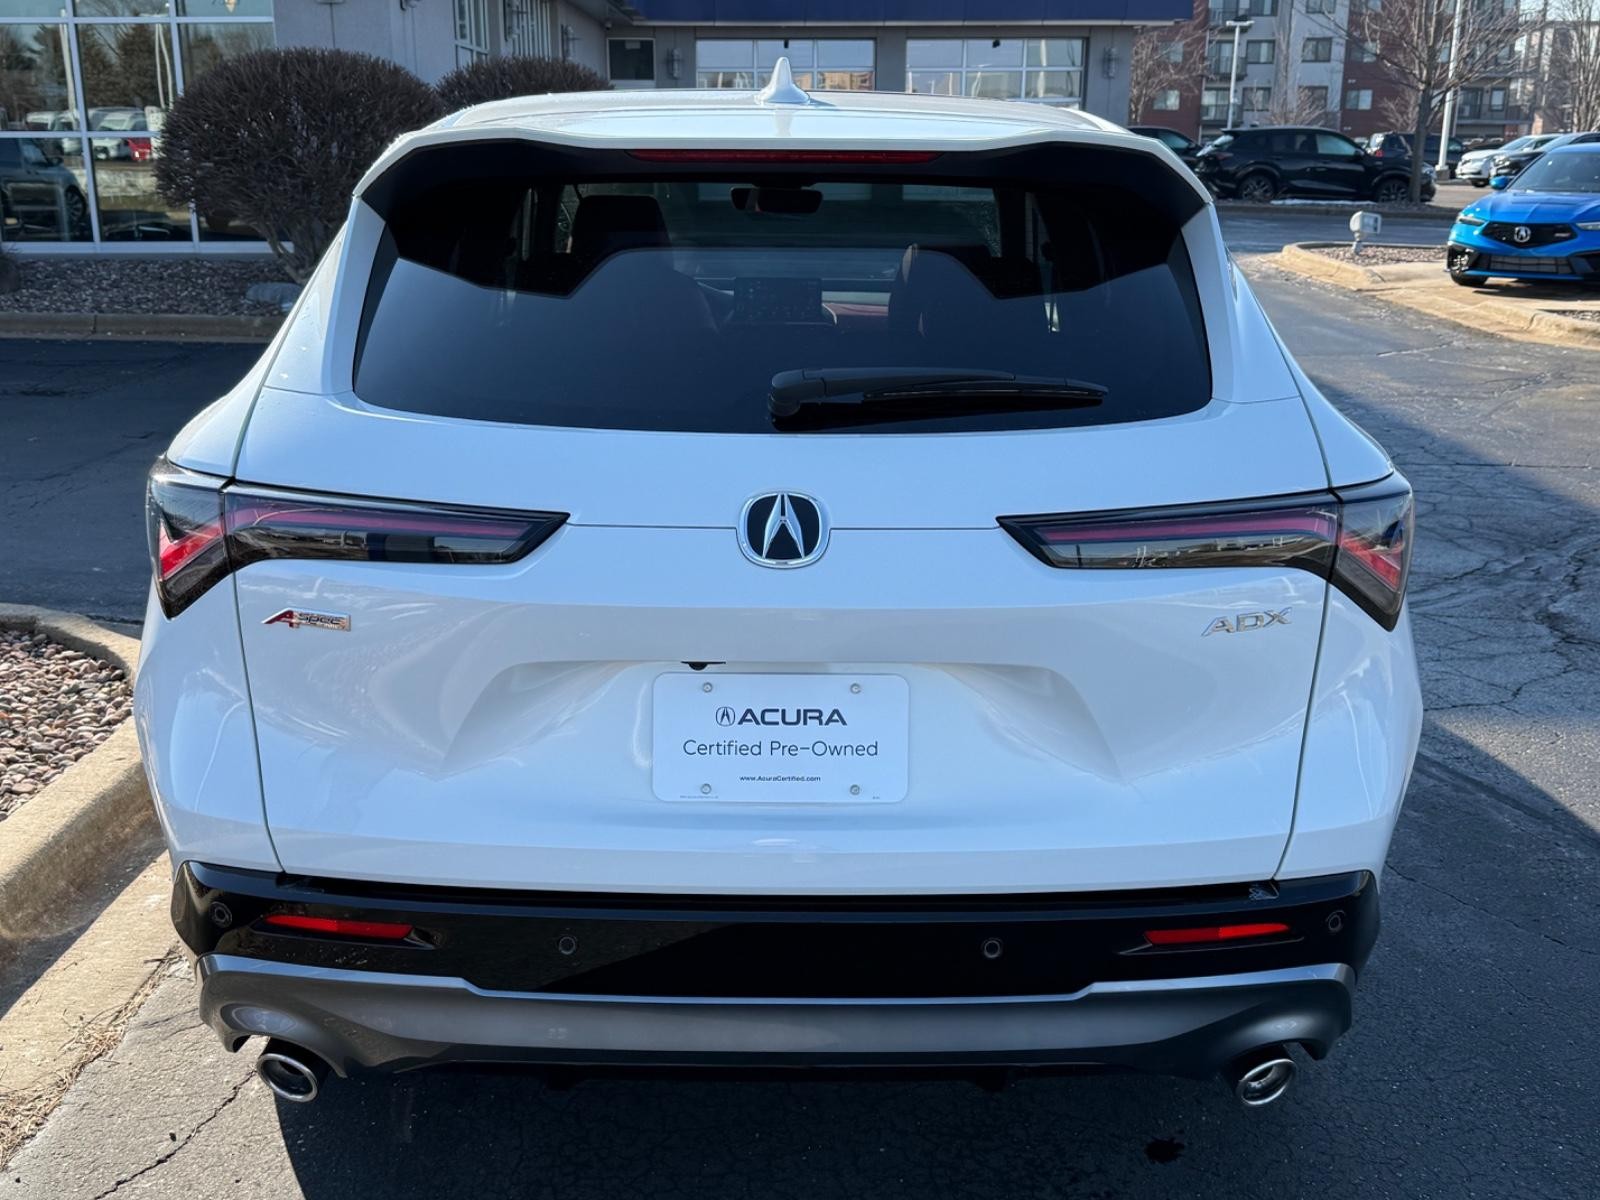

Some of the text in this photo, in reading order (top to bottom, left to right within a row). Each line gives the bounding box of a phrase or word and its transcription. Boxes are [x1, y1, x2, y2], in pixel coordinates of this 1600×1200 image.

[1200, 606, 1293, 637] ADX
[737, 708, 847, 726] ACURA
[683, 739, 878, 756] Certified Pre-Owned
